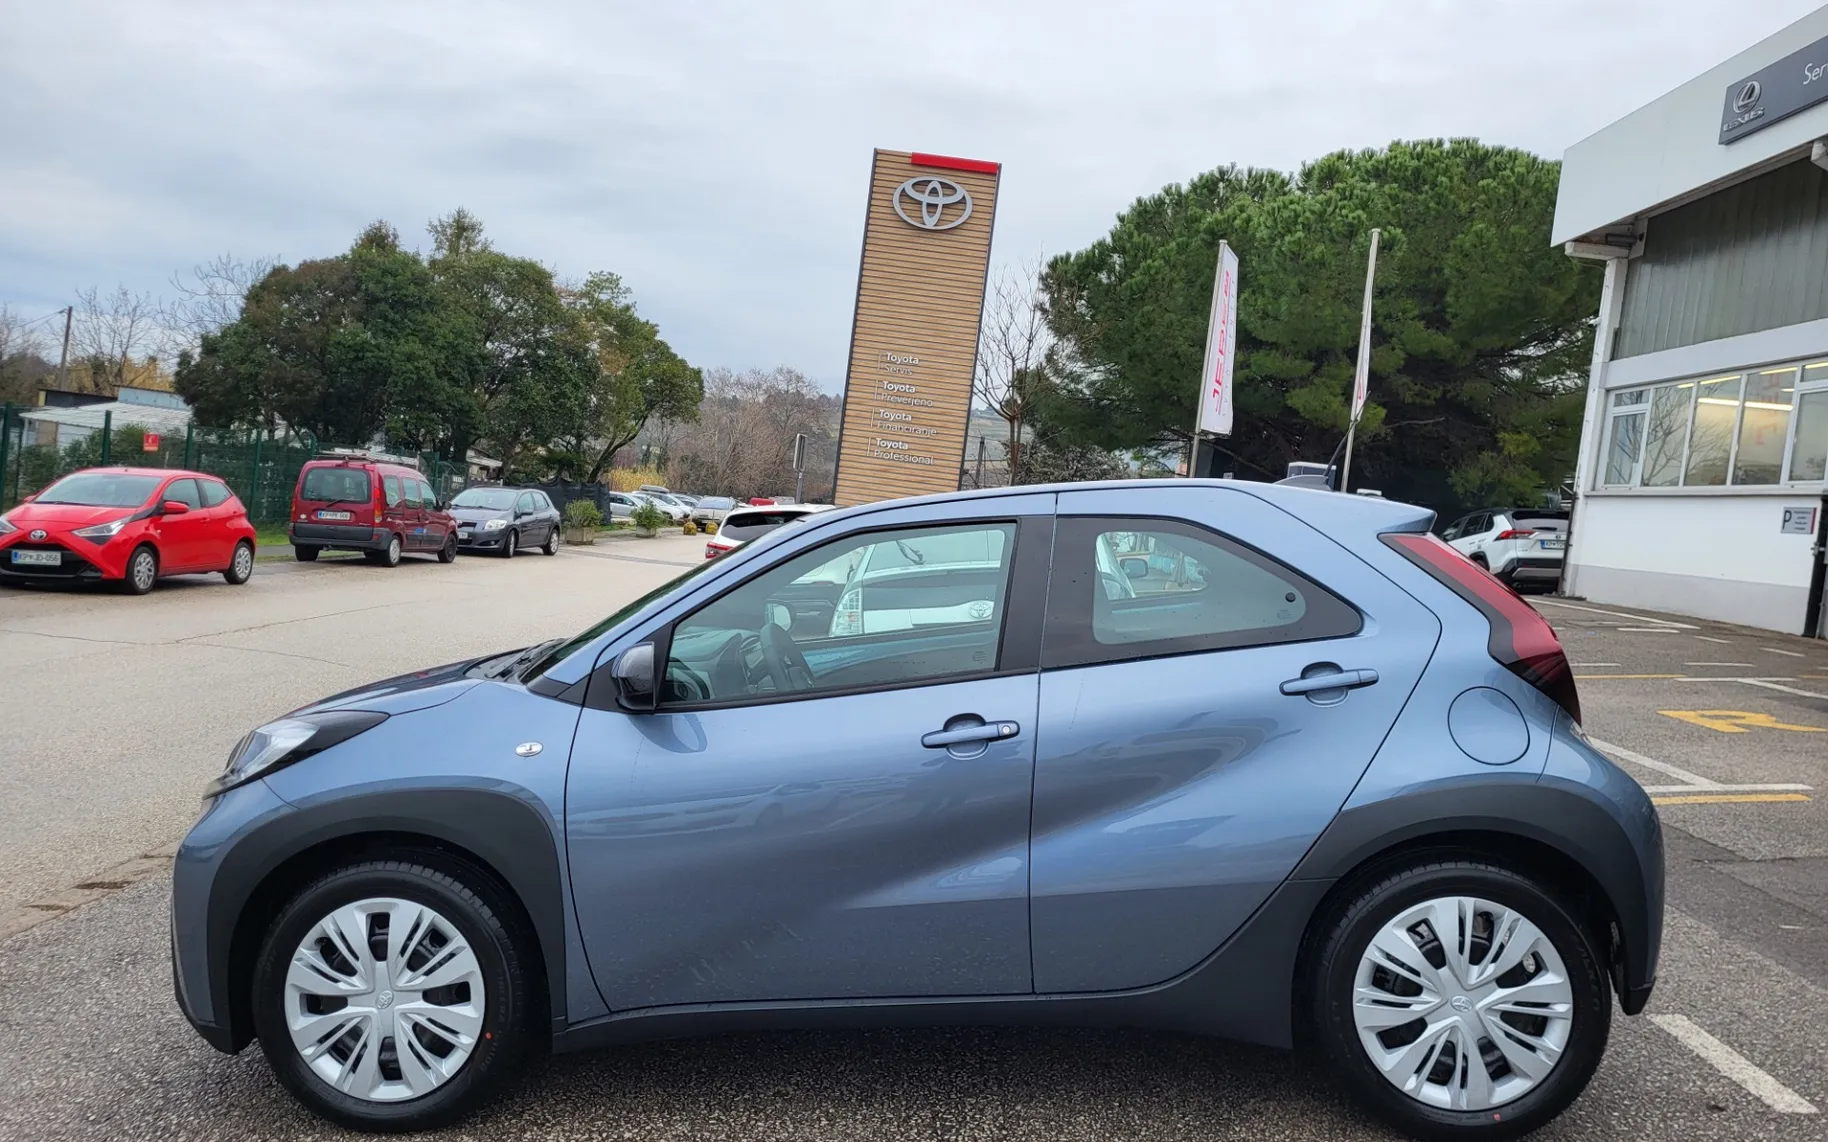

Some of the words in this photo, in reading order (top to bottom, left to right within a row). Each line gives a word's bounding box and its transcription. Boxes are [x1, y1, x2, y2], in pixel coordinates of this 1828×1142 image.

[886, 351, 920, 364] Toyota
[884, 363, 913, 375] Servis
[883, 380, 916, 393] Toyota
[881, 392, 933, 407] Preverjeno
[879, 409, 912, 421] Toyota
[877, 420, 937, 437] Financiranje
[876, 438, 909, 450] Toyota
[874, 449, 934, 465] Professional
